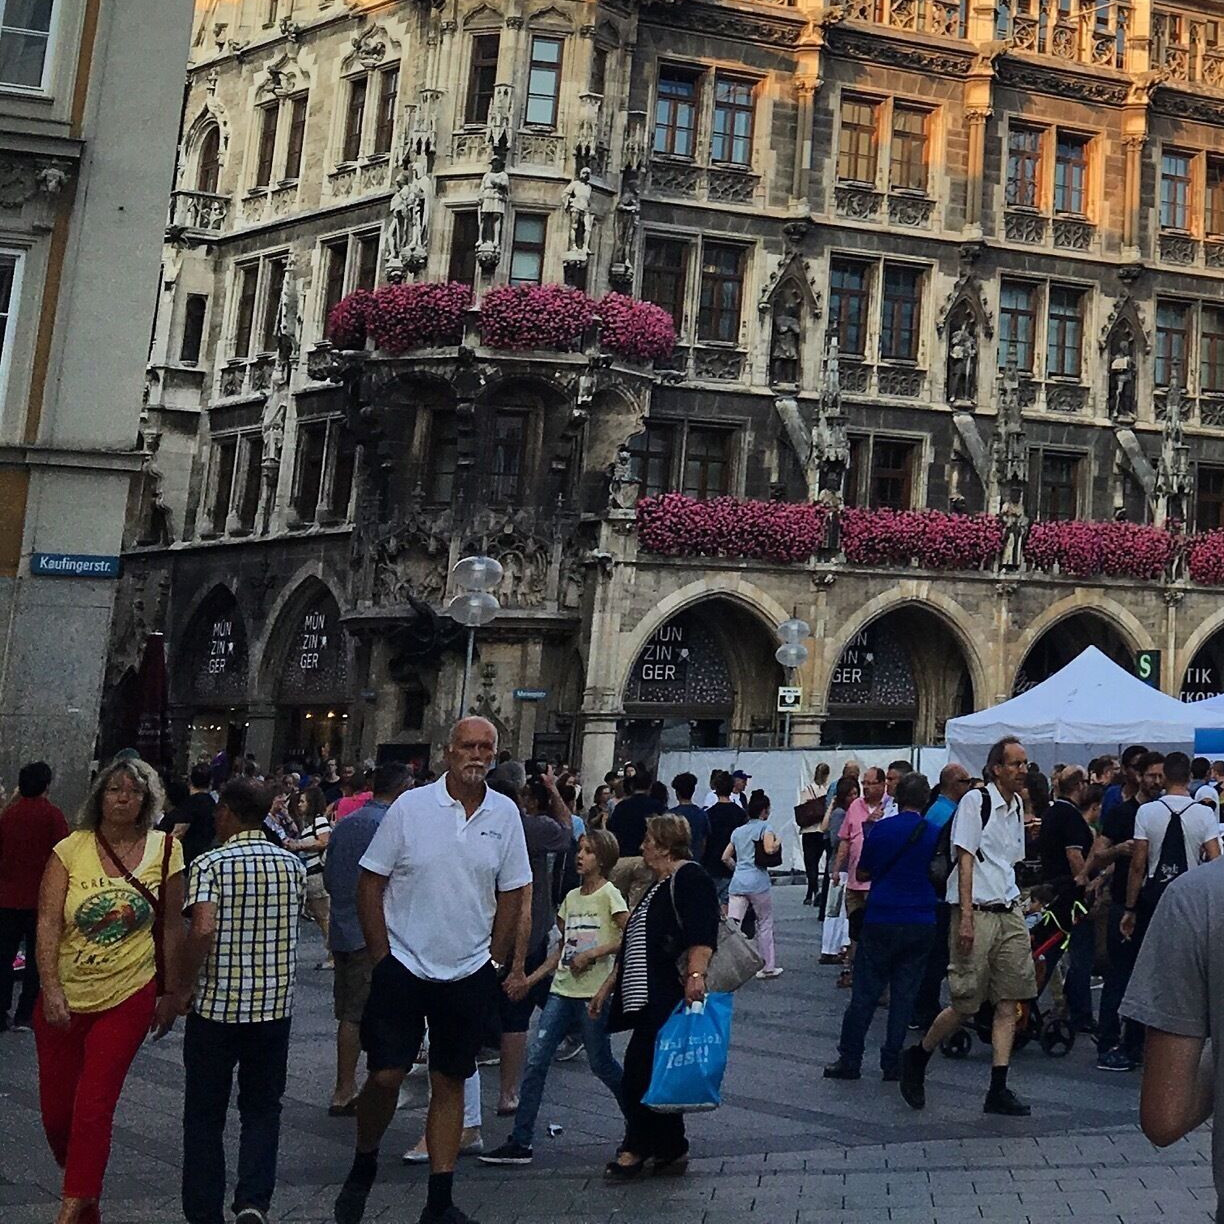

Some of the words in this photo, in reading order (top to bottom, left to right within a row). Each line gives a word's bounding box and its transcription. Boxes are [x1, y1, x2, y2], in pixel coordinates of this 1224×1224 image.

[39, 556, 111, 574] Kaufingerstr.
[211, 640, 226, 655] ZIN
[302, 634, 319, 649] ZIN
[300, 653, 319, 669] GER
[643, 645, 672, 661] ZIN
[209, 659, 226, 673] GER
[642, 664, 676, 680] GER
[1139, 654, 1151, 678] S
[666, 1045, 709, 1069] fest!
